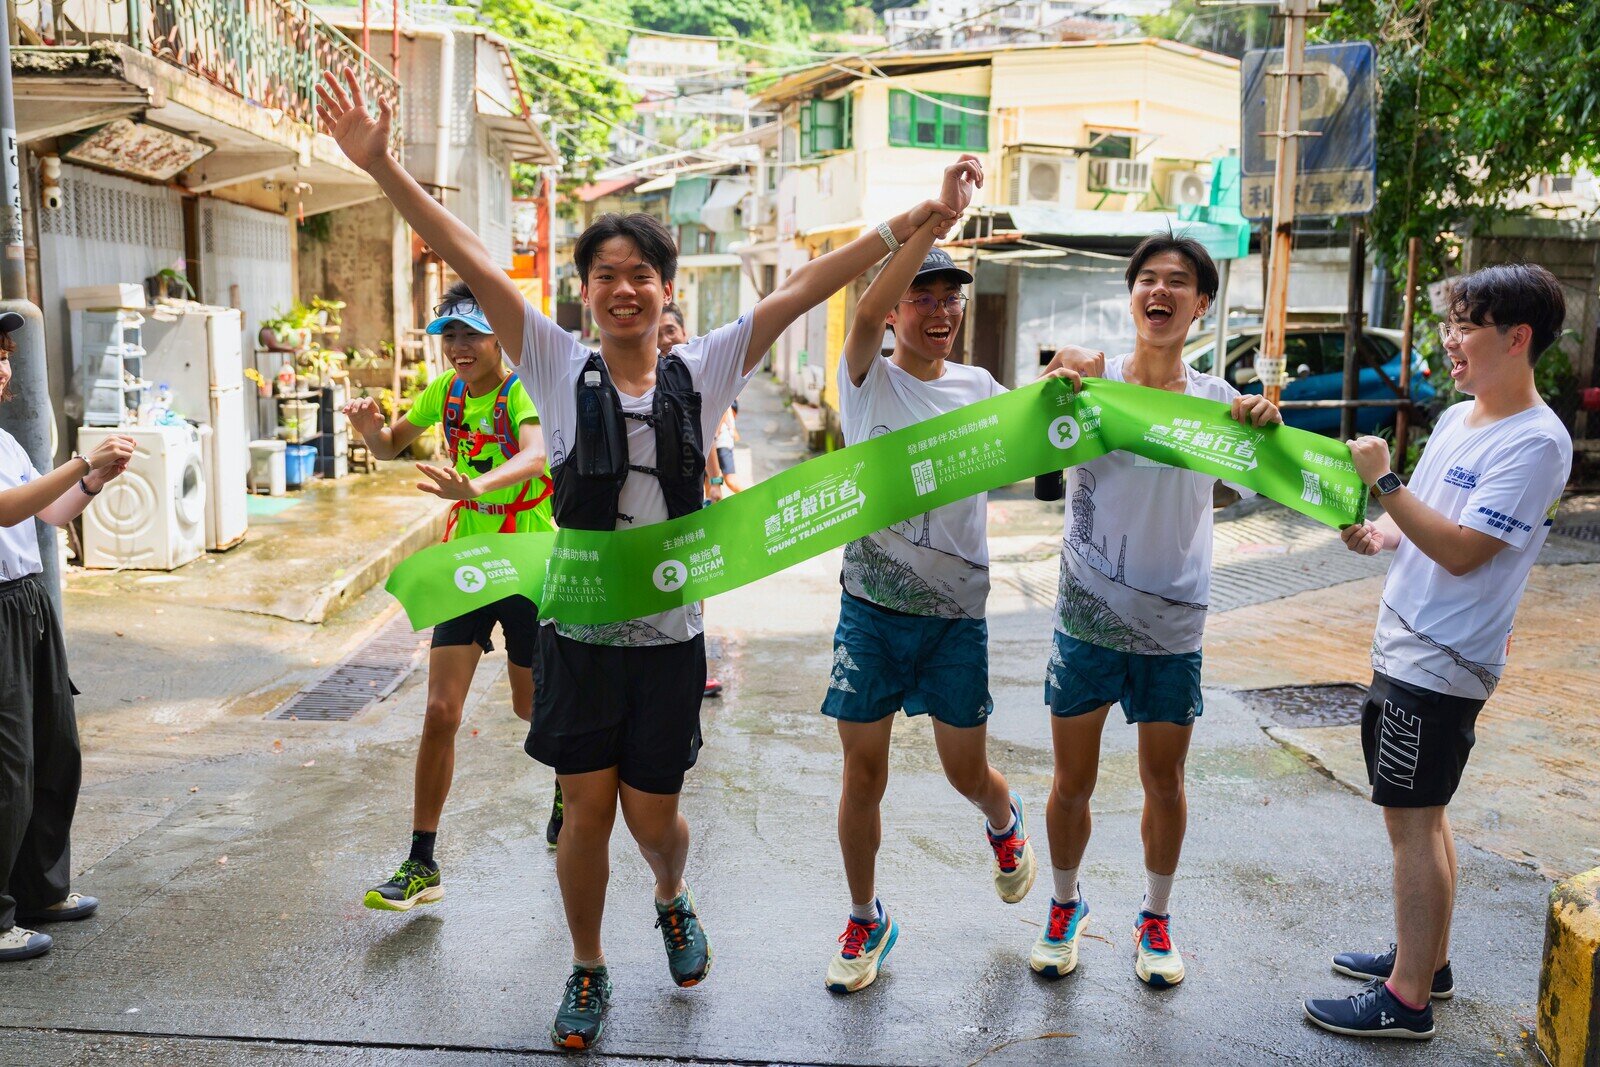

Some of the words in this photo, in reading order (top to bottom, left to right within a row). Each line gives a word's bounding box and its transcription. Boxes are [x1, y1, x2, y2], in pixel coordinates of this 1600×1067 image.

[1264, 60, 1350, 161] P
[1248, 179, 1366, 209] 利車場
[907, 414, 999, 456] 發展夥伴及捐助機構
[1143, 435, 1177, 449] YOUNG
[1178, 445, 1244, 471] TRAILWALKER
[1303, 449, 1357, 473] 發展夥伴及
[939, 463, 958, 476] THE
[939, 456, 1007, 485] FOUNDATION
[1325, 498, 1356, 514] FOUND
[663, 528, 706, 551] 主辦機構
[767, 536, 797, 556] YOUNG
[798, 507, 858, 540] TRAILWALKER
[689, 544, 721, 565] 樂施會
[487, 567, 518, 579] OXFAM
[690, 556, 725, 577] OXFAM
[692, 575, 709, 585] Hong
[709, 570, 724, 580] Kong
[545, 593, 607, 603] OUNDATION
[1377, 699, 1421, 790] NIKE
